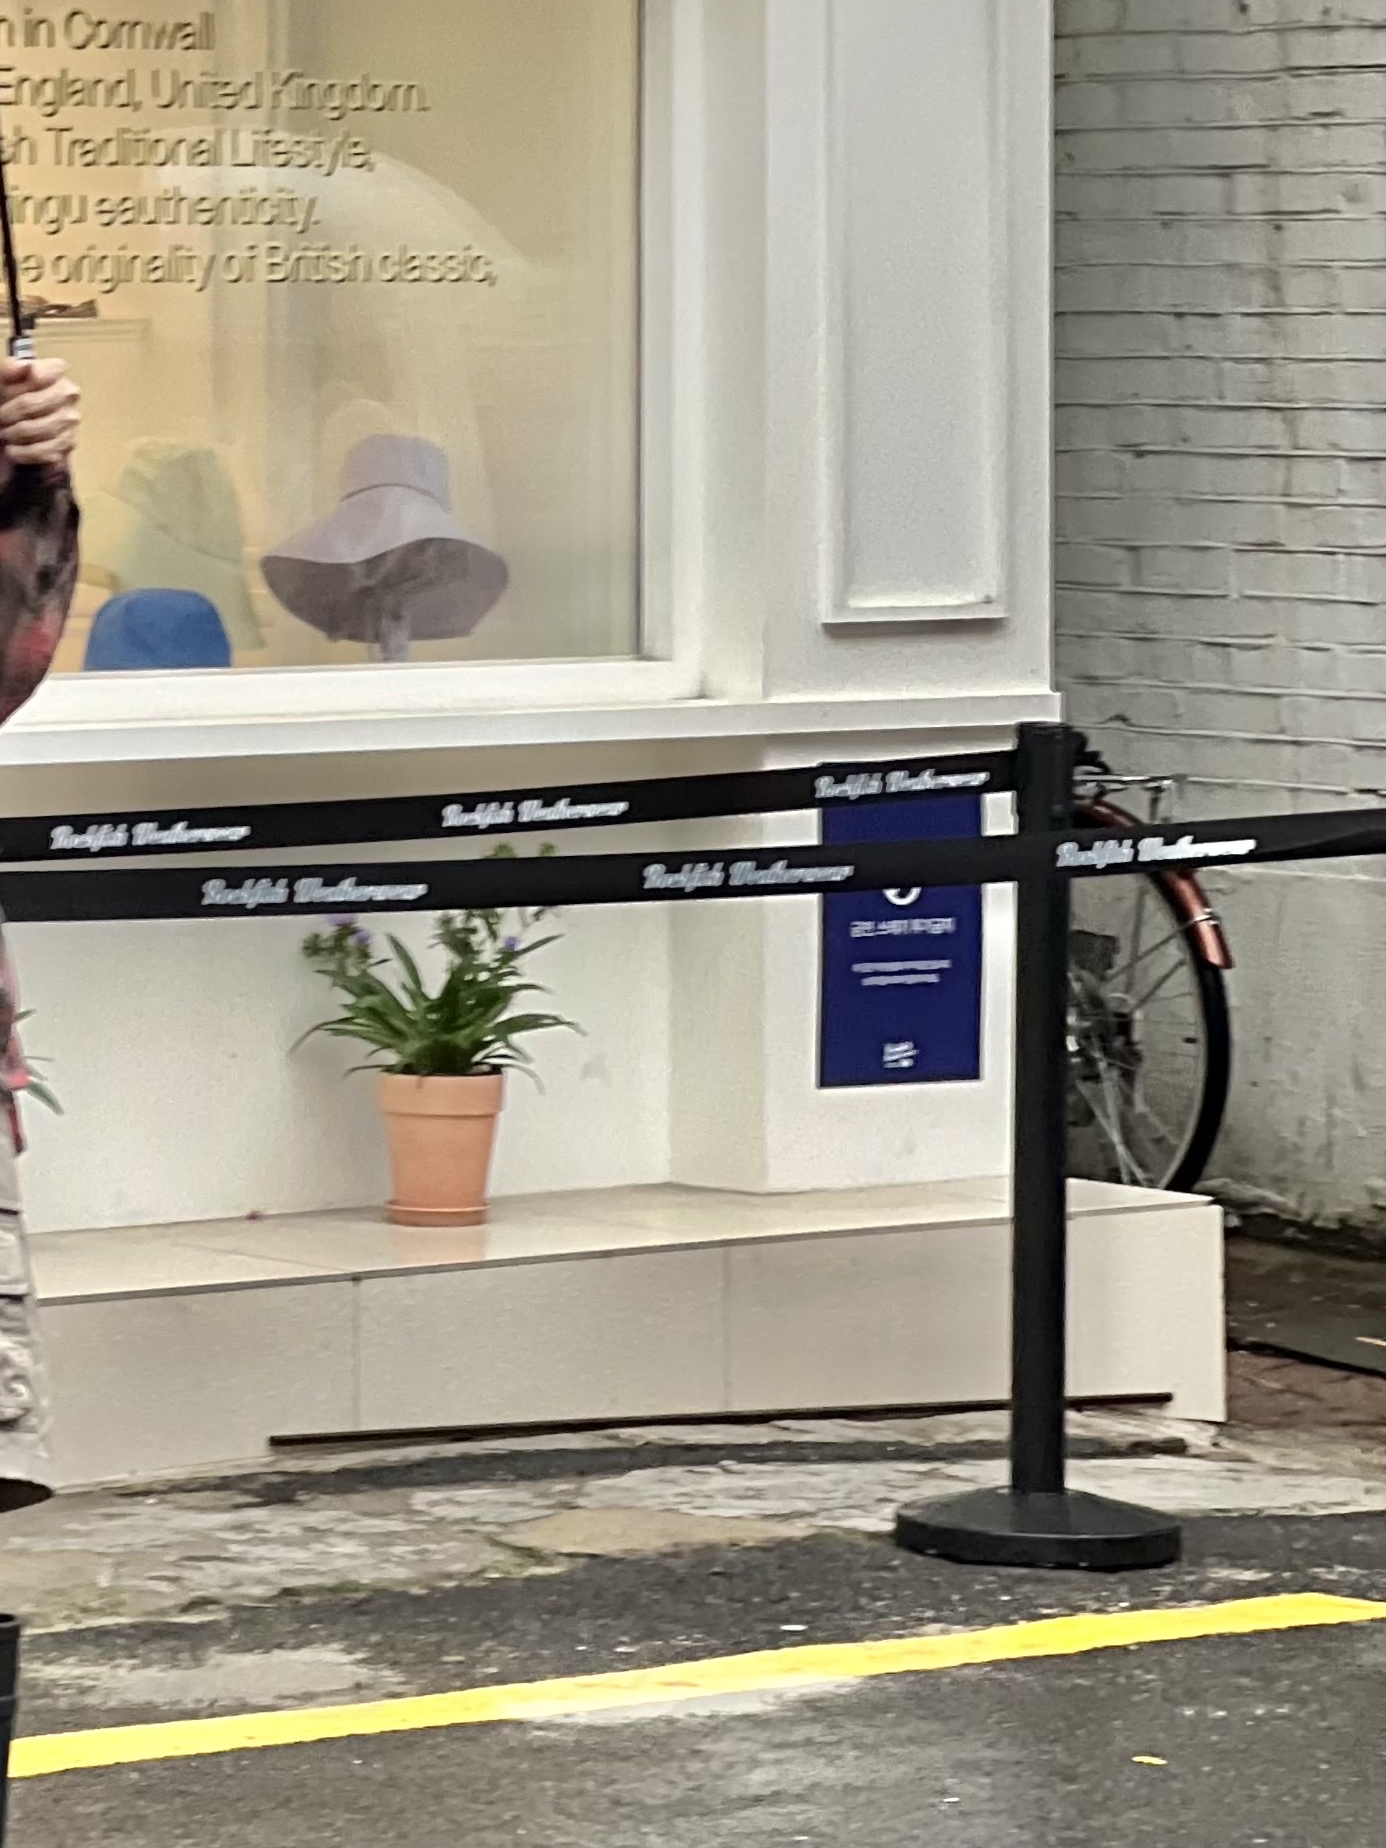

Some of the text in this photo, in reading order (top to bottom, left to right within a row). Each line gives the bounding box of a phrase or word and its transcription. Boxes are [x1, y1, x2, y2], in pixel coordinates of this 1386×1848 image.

[23, 7, 56, 48] in
[63, 8, 214, 50] Cornwall
[151, 68, 263, 111] United
[270, 69, 431, 121] Kingdom.
[43, 126, 222, 168] Traditional
[51, 244, 216, 294] originality
[223, 244, 259, 283] of
[266, 243, 372, 284] British
